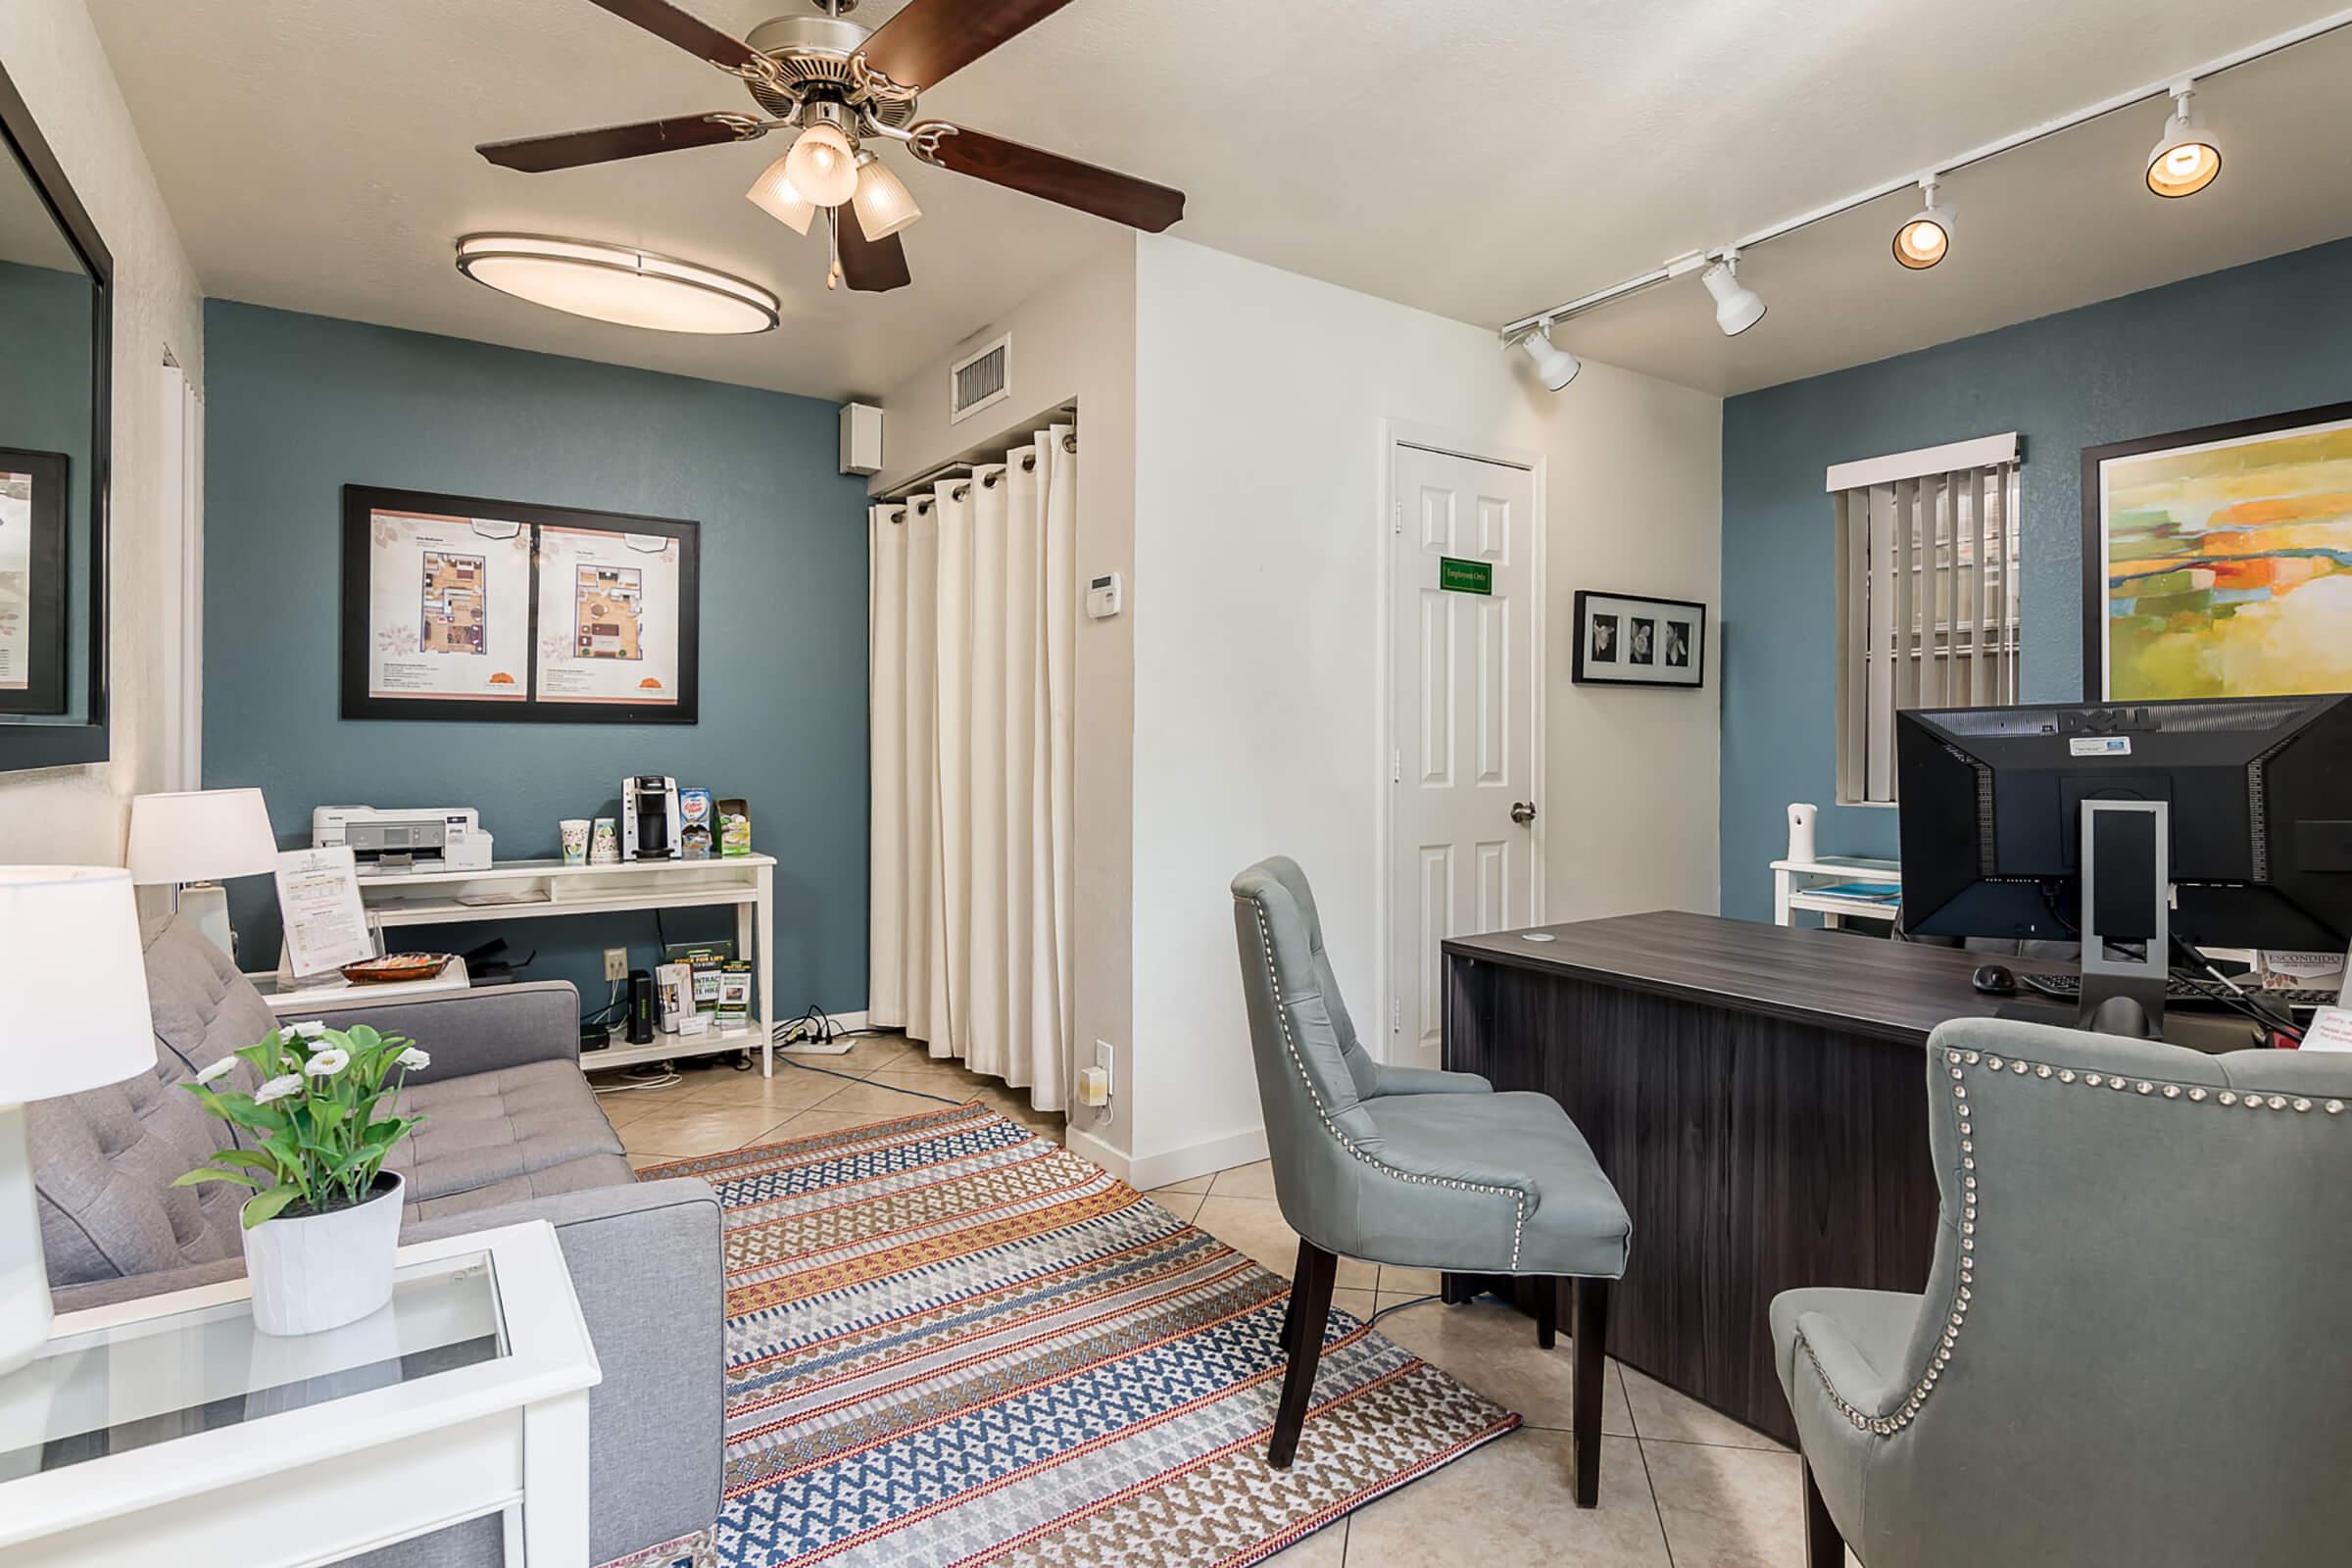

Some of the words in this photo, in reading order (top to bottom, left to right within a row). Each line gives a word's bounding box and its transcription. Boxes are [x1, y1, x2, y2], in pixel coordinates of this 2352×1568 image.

[1474, 571, 1486, 580] Only
[2059, 708, 2161, 733] DELL
[2269, 955, 2340, 963] ESCONDIDO
